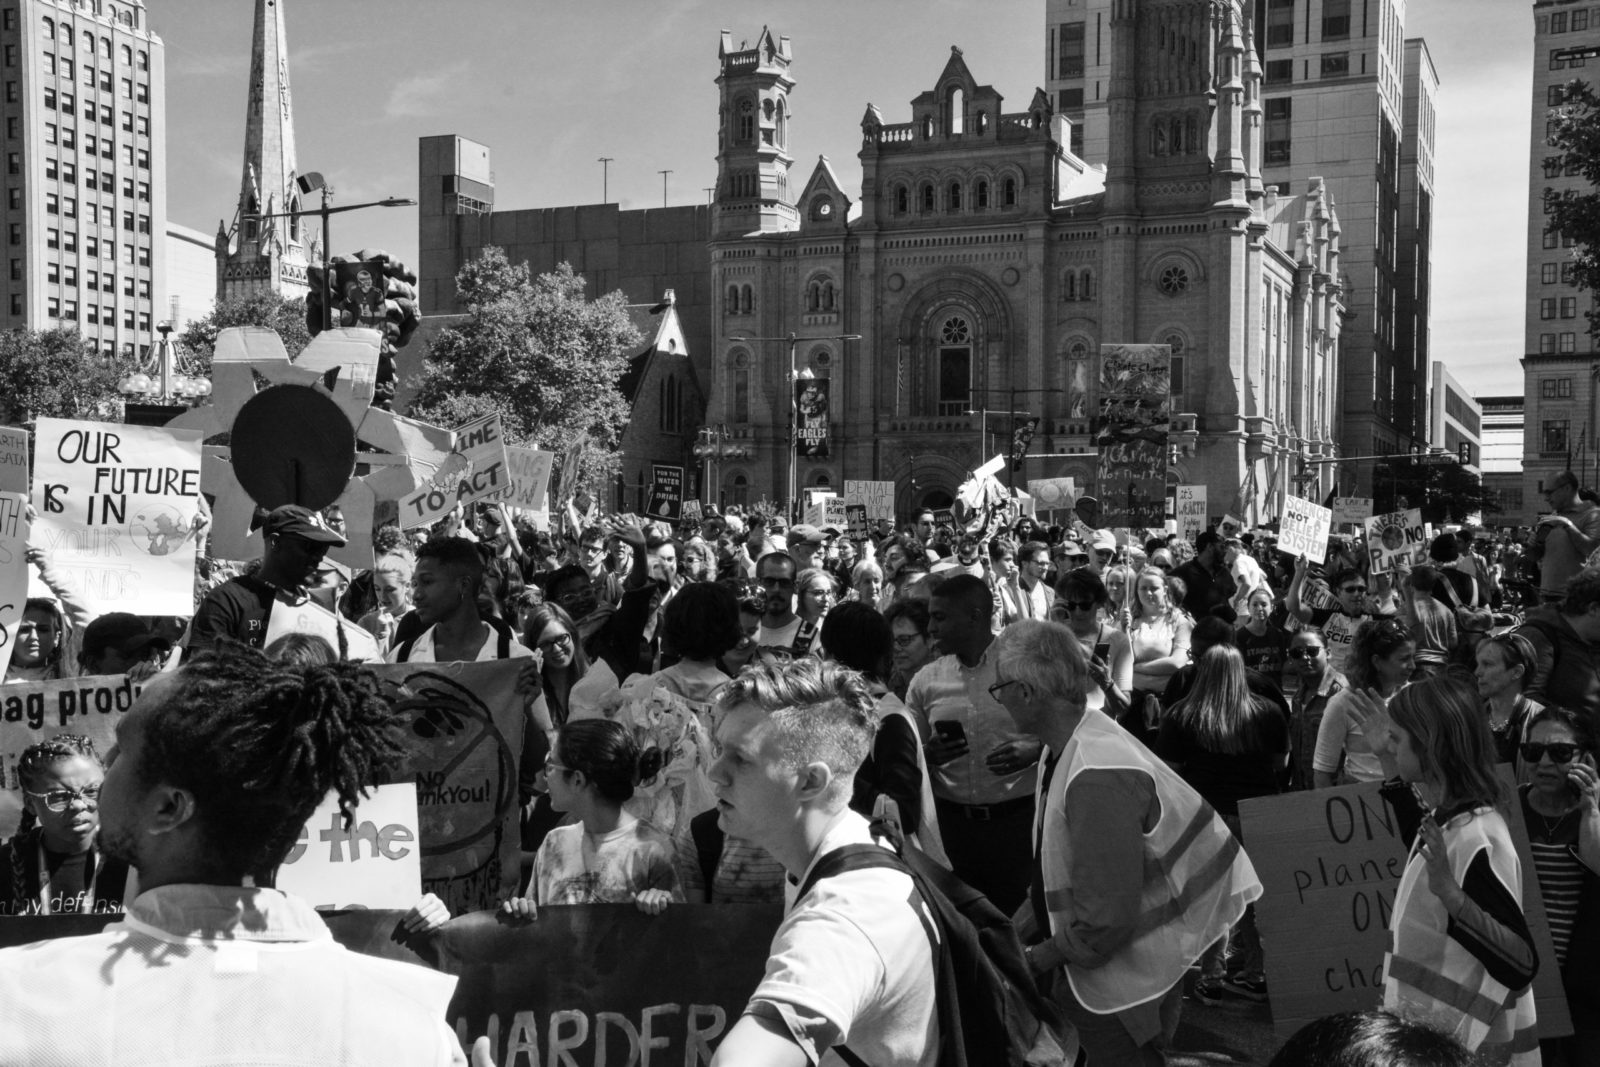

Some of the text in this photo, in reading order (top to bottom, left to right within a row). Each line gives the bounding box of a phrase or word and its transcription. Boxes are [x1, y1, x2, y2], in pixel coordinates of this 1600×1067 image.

[455, 418, 499, 453] IME
[797, 428, 827, 439] EAGLES
[805, 420, 820, 429] FLY
[57, 429, 122, 464] OUR
[805, 438, 820, 447] FLY
[94, 467, 200, 496] FUTURE
[408, 490, 446, 518] TO
[456, 460, 503, 502] ACT
[657, 477, 680, 486] WATER
[847, 480, 894, 496] DENIAL
[44, 484, 126, 525] IS IN
[656, 492, 679, 502] DRINK
[868, 495, 886, 505] NOT
[1286, 496, 1330, 523] SCIENCE
[1282, 517, 1322, 540] BELIEF
[1287, 510, 1309, 524] NOT
[1368, 513, 1409, 541] THERE'S
[44, 528, 122, 557] YOUR
[1282, 530, 1326, 558] SYSTEM
[1404, 525, 1424, 544] NO
[1370, 543, 1428, 574] PLANET B
[0, 678, 142, 729] ag prod
[416, 770, 446, 790] NO
[320, 800, 414, 863] the
[1326, 795, 1395, 845] ON
[1294, 855, 1400, 905] plane
